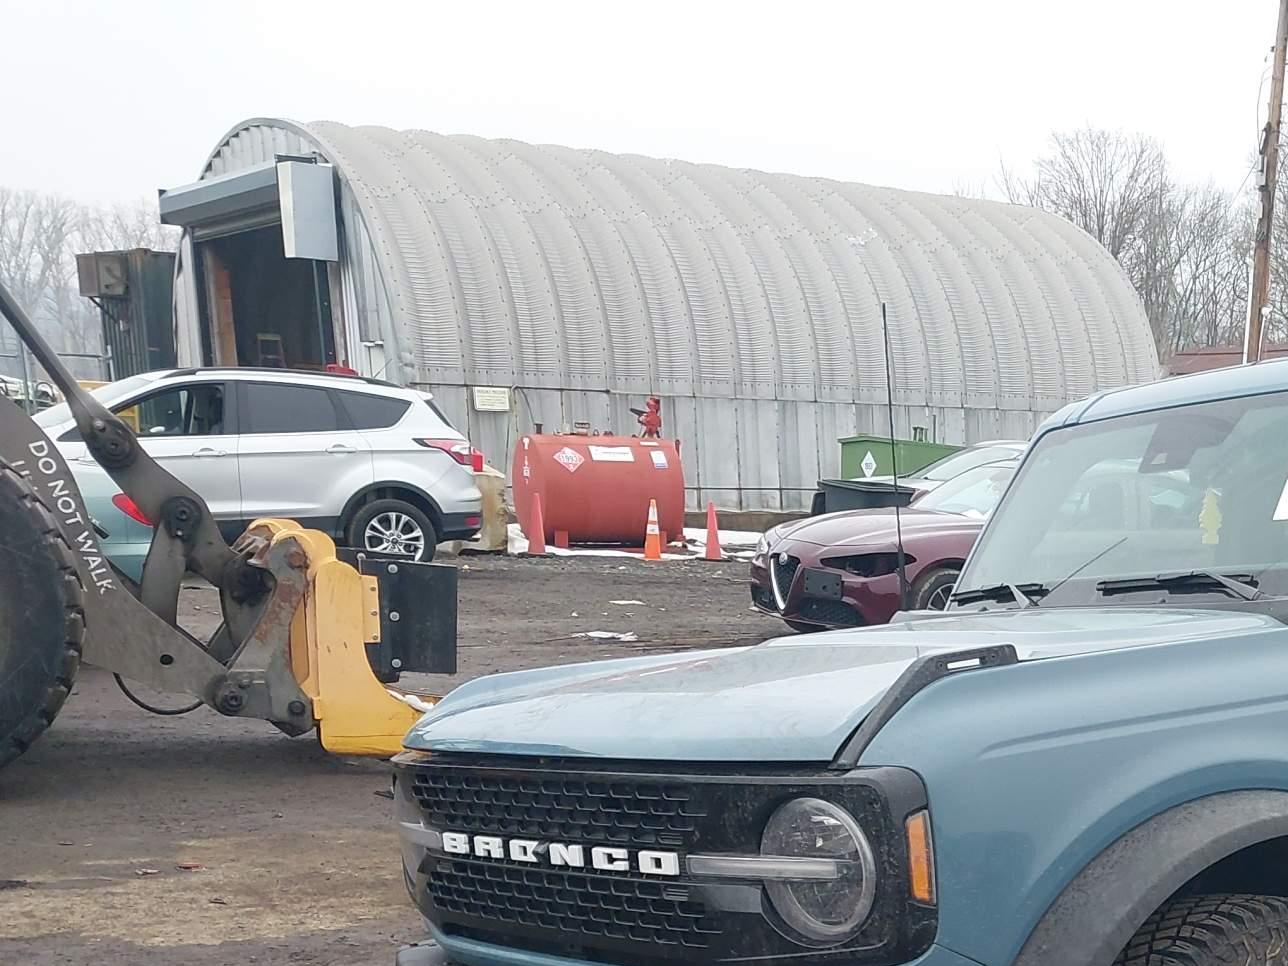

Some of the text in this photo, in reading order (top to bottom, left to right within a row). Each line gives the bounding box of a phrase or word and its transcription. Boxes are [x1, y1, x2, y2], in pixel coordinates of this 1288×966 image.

[28, 440, 118, 594] DO NOT WALK
[442, 831, 680, 876] BRONCO
